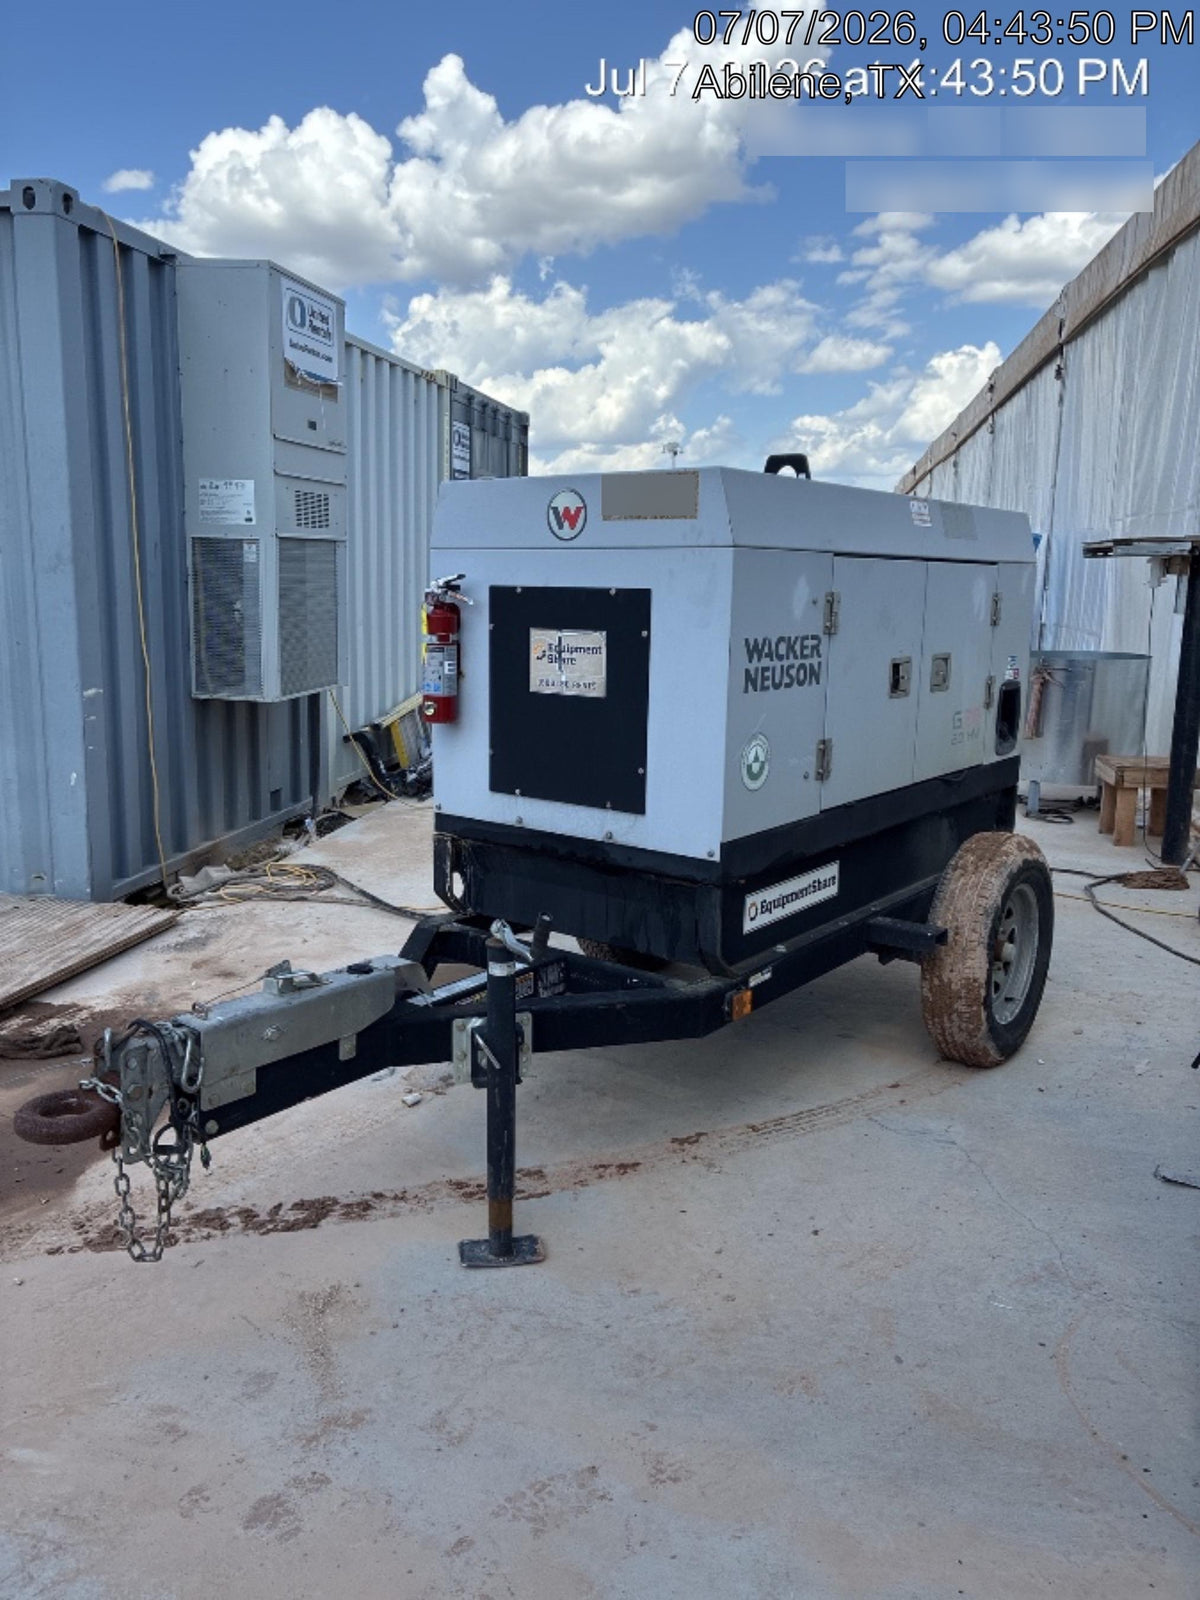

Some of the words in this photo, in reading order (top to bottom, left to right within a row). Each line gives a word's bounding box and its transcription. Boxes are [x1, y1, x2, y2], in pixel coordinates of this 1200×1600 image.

[744, 634, 822, 664] WACKER
[743, 661, 822, 694] NEUSON
[760, 874, 838, 915] EquipmentShare
